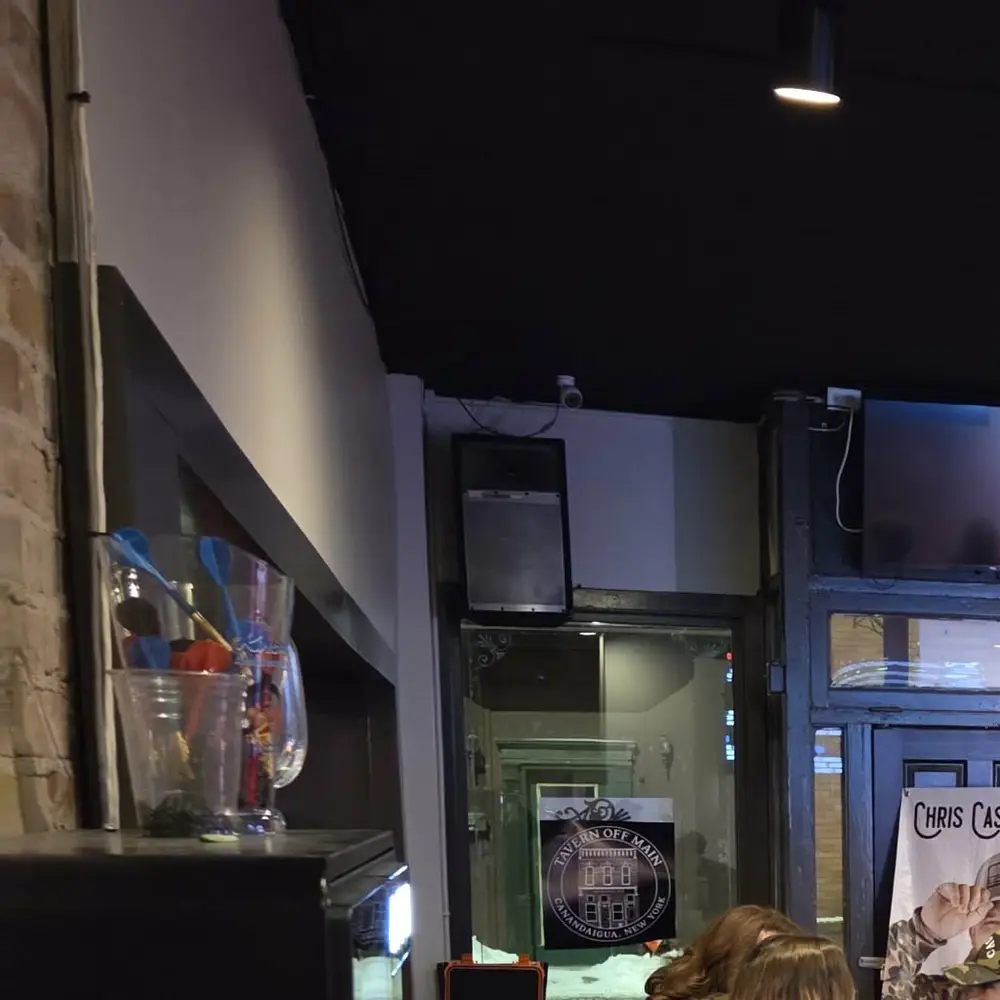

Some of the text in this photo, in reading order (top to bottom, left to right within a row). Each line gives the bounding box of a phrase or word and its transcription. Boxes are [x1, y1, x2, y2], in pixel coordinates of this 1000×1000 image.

[914, 801, 963, 839] CHRIS
[554, 828, 663, 867] TAVERN OFF MAIN
[623, 919, 648, 936] NEW
[647, 896, 666, 920] YORK
